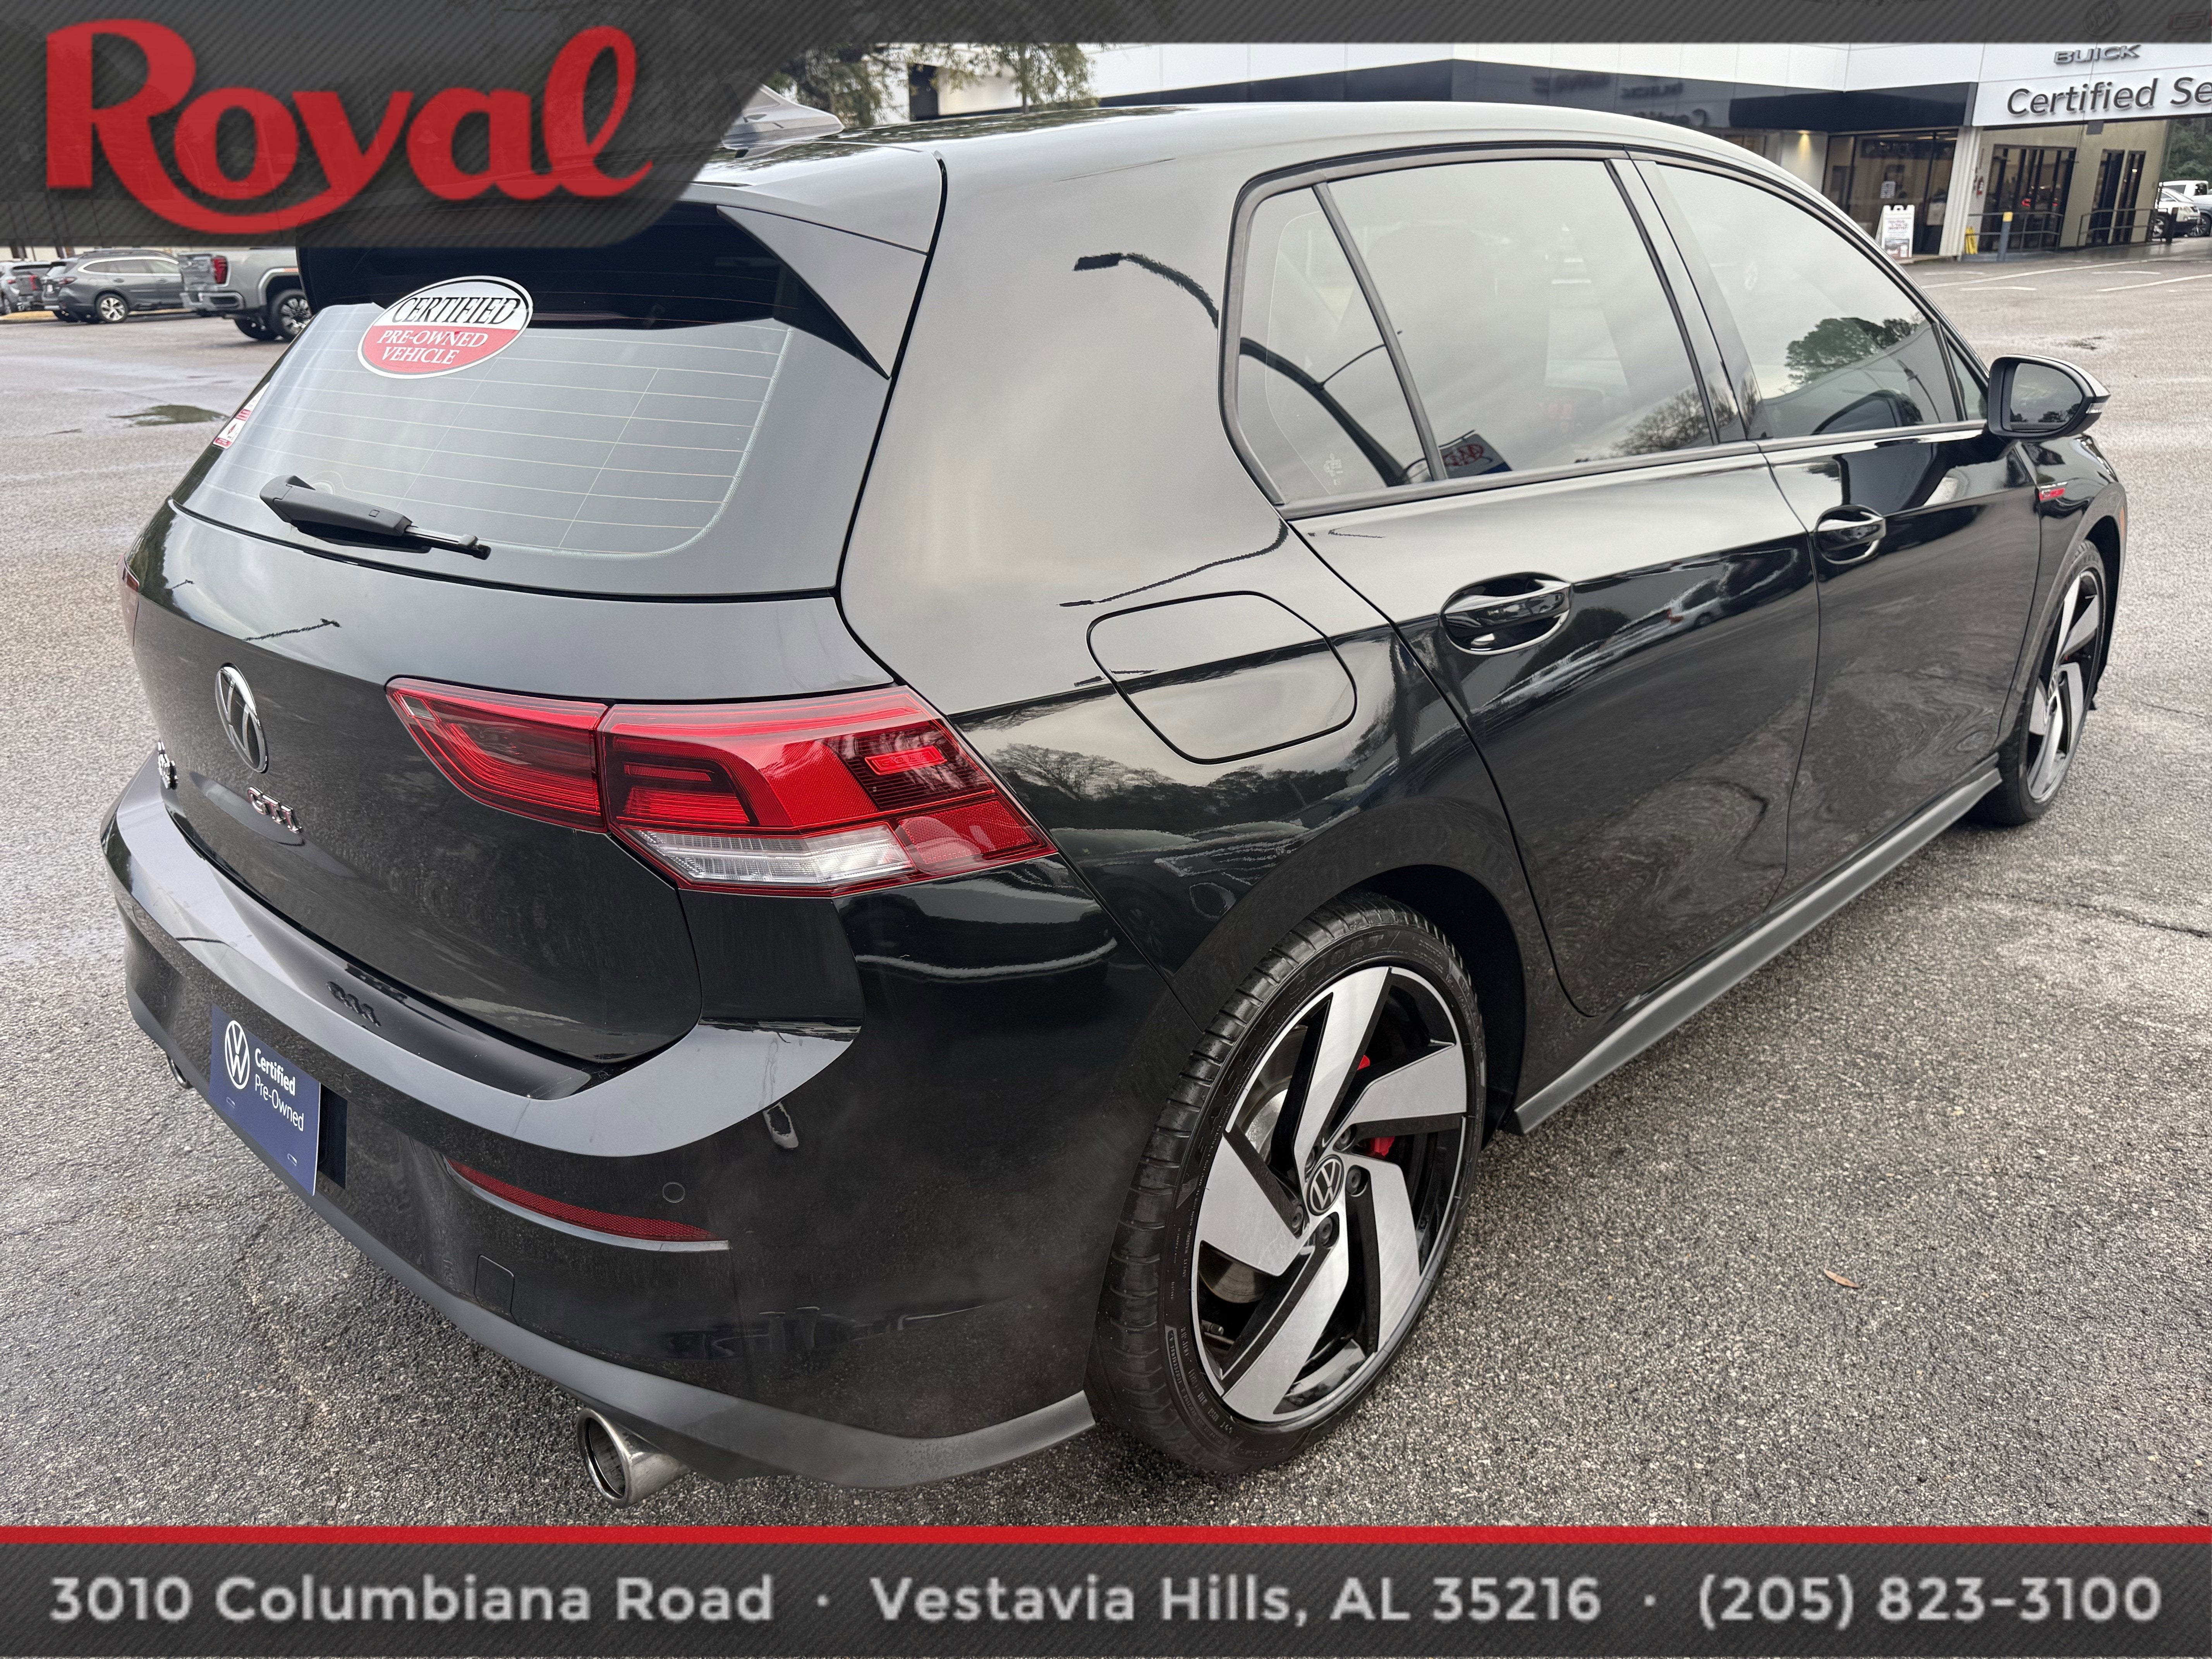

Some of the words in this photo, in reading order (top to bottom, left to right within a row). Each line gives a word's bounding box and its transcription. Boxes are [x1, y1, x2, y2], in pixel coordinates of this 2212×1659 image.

[2054, 45, 2141, 65] BUICK
[2007, 78, 2159, 116] Certified
[392, 297, 521, 325] CERTIFIED
[377, 330, 488, 347] PRE-OWNED
[382, 347, 460, 364] VEHICLE
[248, 787, 302, 833] GTI
[1289, 934, 1384, 1000] SPORT
[255, 1048, 295, 1096] Certified
[255, 1073, 304, 1131] Pre-Owned
